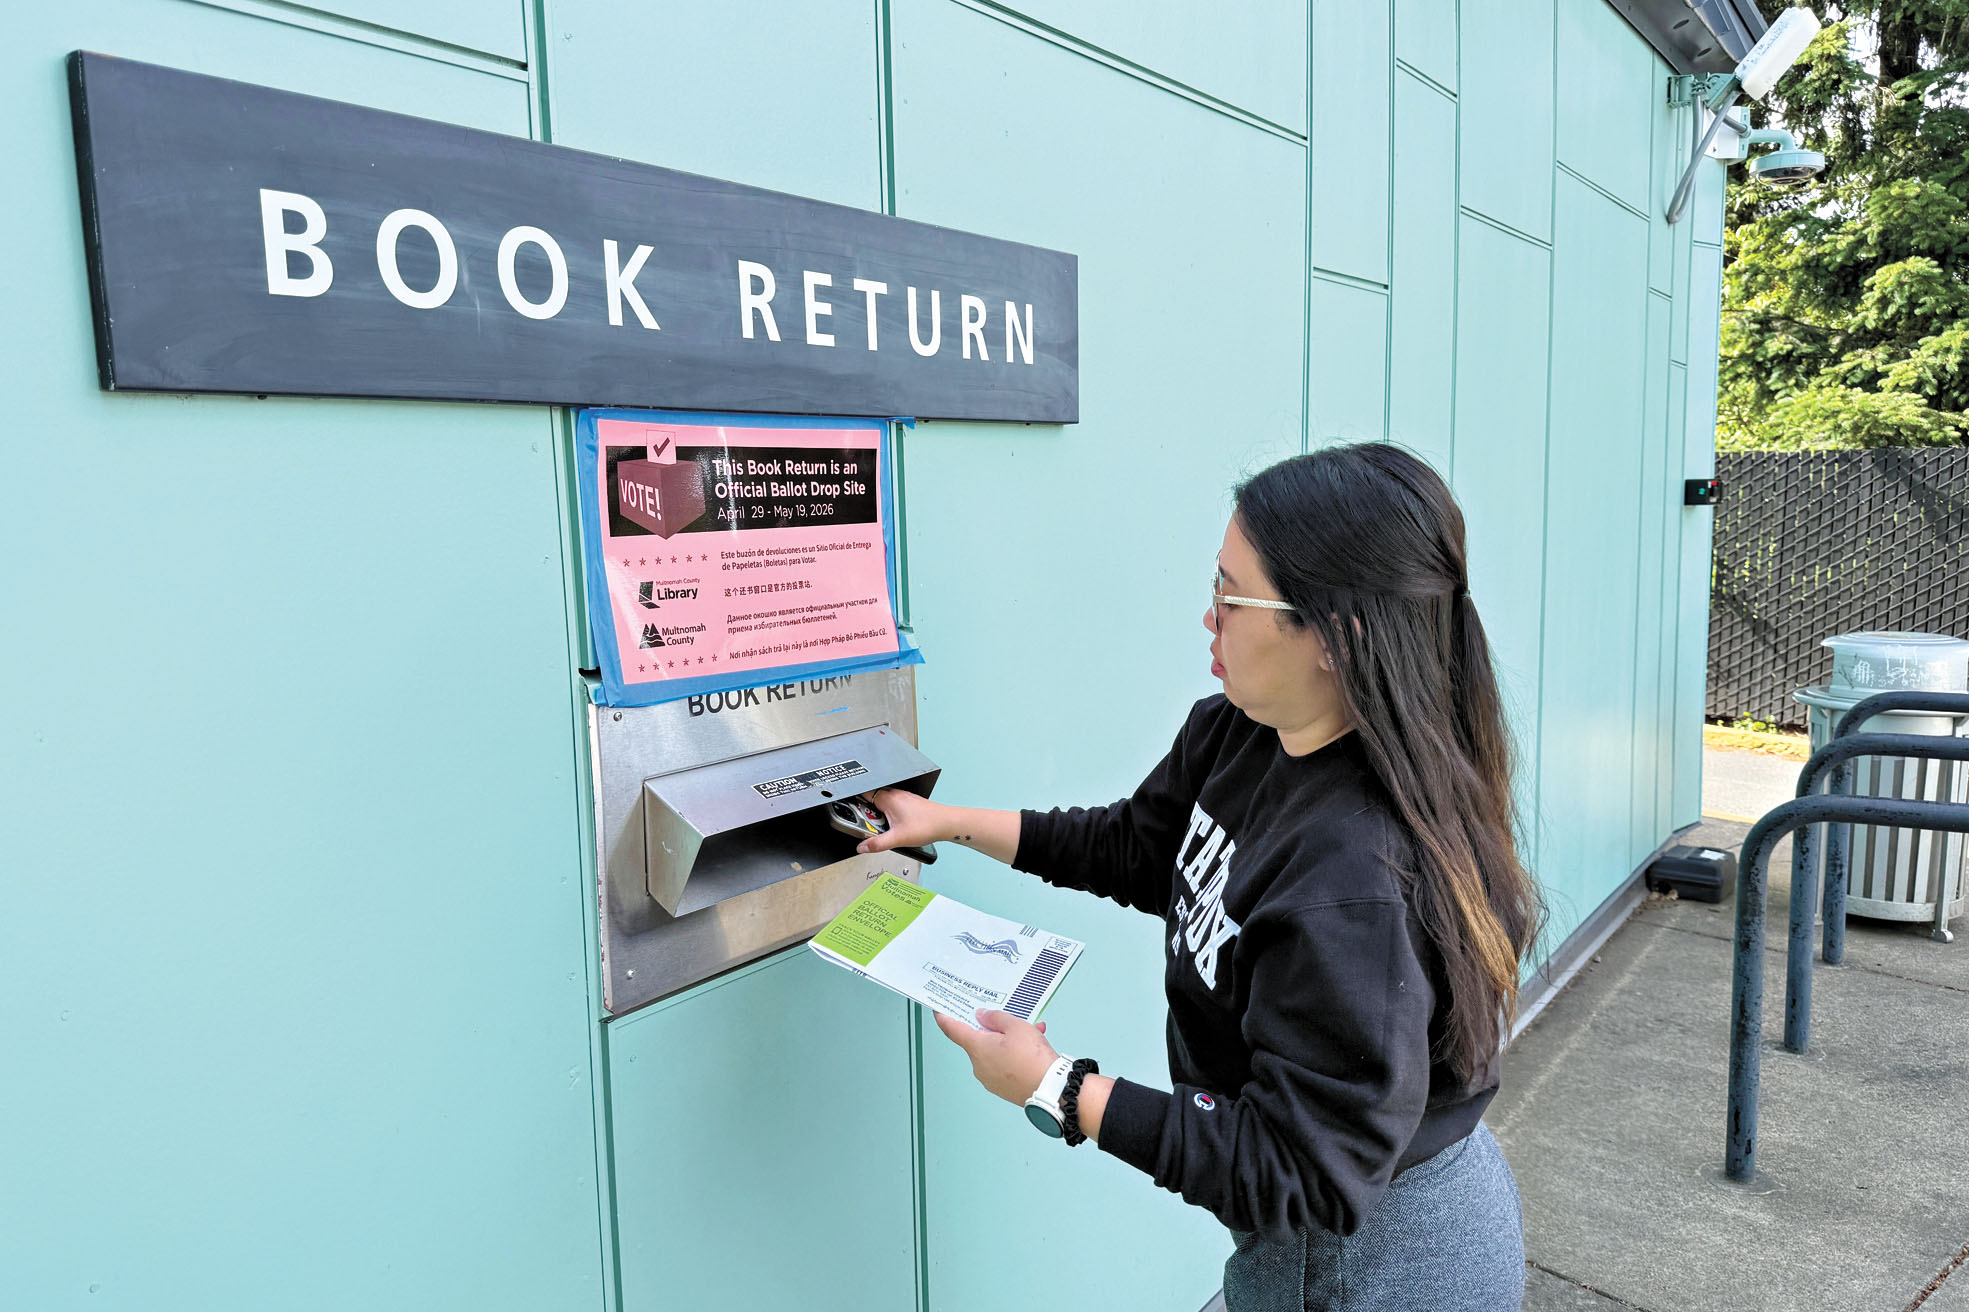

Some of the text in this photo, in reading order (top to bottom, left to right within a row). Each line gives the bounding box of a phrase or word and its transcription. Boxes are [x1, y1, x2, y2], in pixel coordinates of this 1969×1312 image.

[260, 188, 1035, 366] BOOK RETURN
[712, 459, 858, 476] This Book Return is an
[714, 480, 866, 498] Official Ballot Drop Site
[620, 478, 662, 521] VOTE!
[717, 506, 745, 522] April
[751, 506, 765, 519] 29
[774, 505, 793, 519] May
[796, 504, 808, 518] 19,
[810, 504, 834, 516] 2026
[721, 551, 735, 560] Este
[736, 549, 756, 559] buzón
[757, 549, 765, 557] de
[765, 546, 801, 556] devoluciones
[829, 542, 845, 551] Oficial
[852, 541, 872, 550] Entrega
[722, 562, 731, 571] de
[732, 560, 763, 571] Papeletas
[763, 557, 789, 568] (Boletas)
[789, 558, 801, 567] para
[657, 587, 698, 601] Library
[727, 613, 752, 625] Данное
[753, 610, 777, 620] окошко
[778, 607, 805, 617] является
[662, 623, 706, 636] Multnomah
[727, 624, 753, 635] приема
[666, 635, 694, 645] County
[758, 645, 773, 656] sách
[688, 688, 760, 717] BOOK
[816, 764, 847, 777] NOTICE
[759, 777, 798, 791] CAUTION
[881, 884, 906, 902] Votes
[884, 881, 921, 902] Multnomah
[852, 909, 887, 928] RETURN
[858, 904, 892, 922] BALLOT
[863, 900, 898, 921] OFFICIAL
[847, 914, 892, 938] ENVELOPE
[931, 965, 963, 985] BUSINESS
[963, 979, 983, 993] REPLY
[983, 988, 999, 999] MAIL
